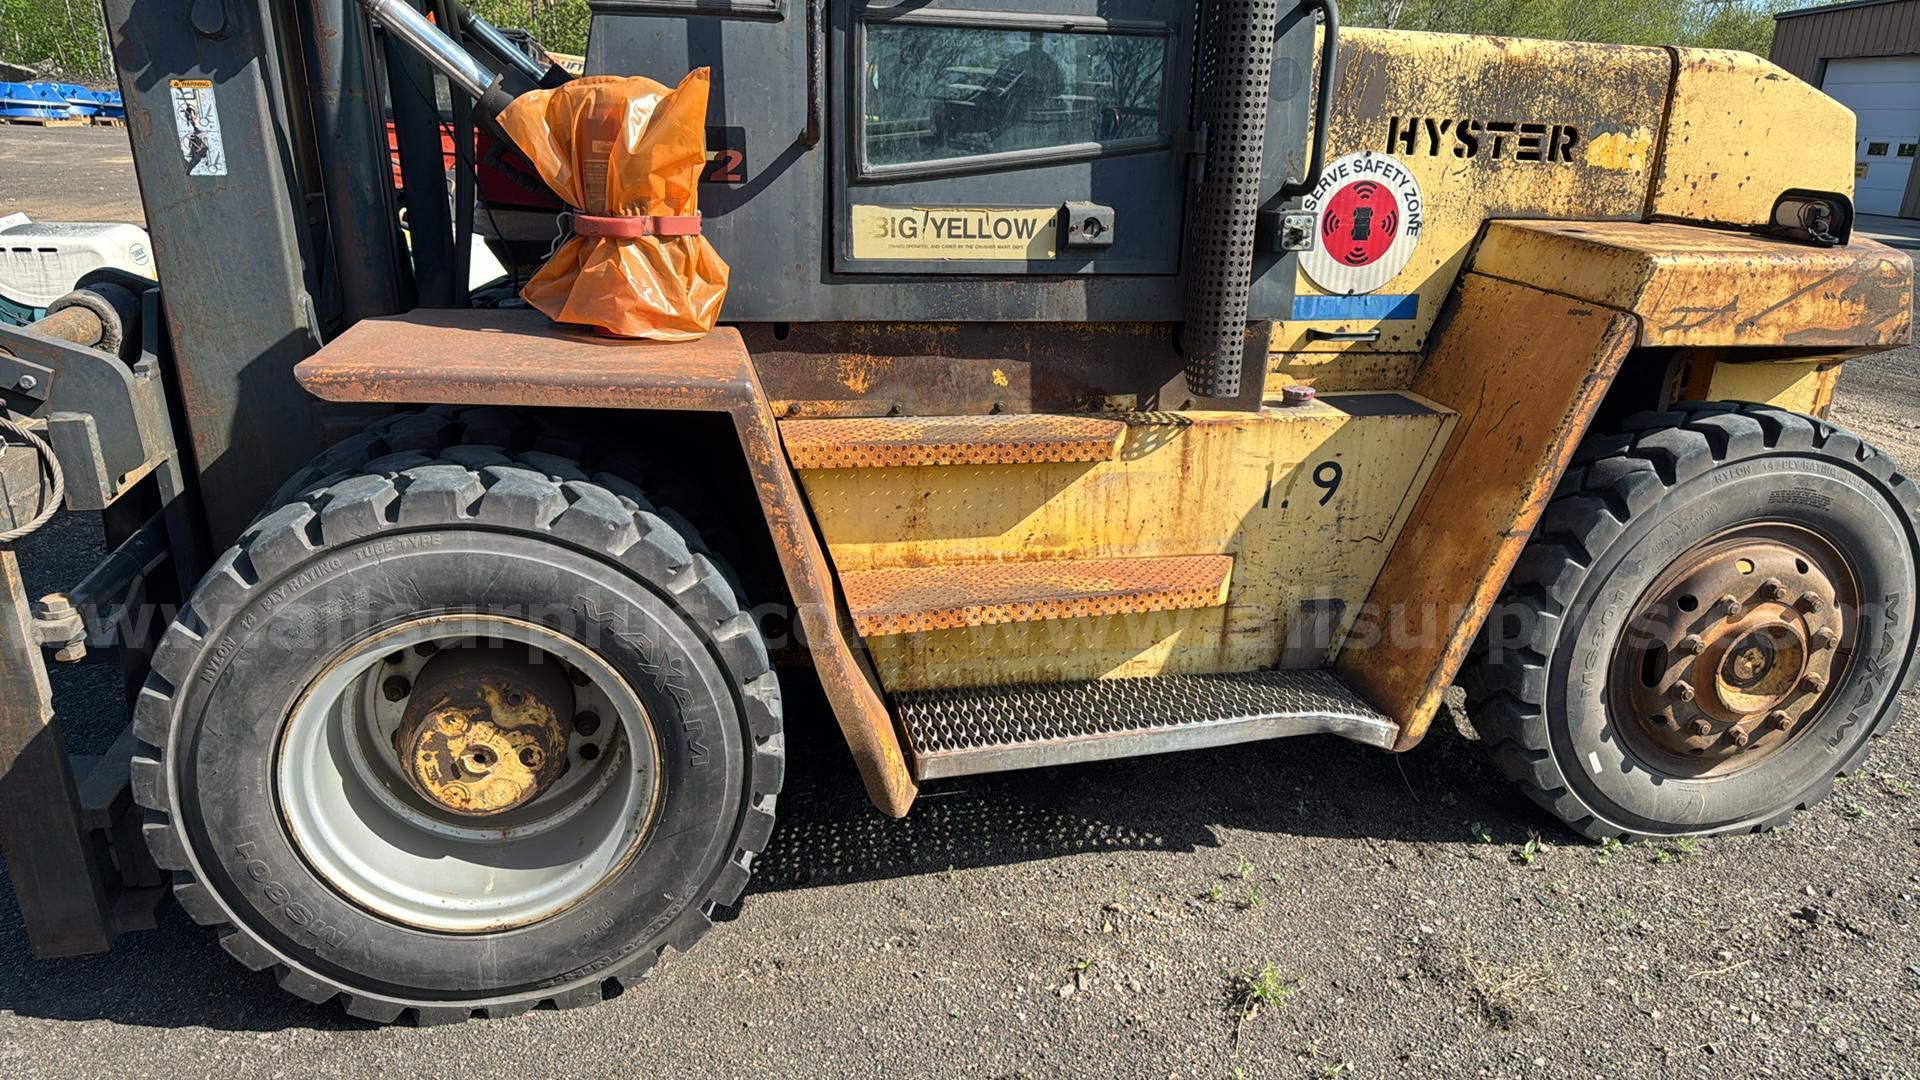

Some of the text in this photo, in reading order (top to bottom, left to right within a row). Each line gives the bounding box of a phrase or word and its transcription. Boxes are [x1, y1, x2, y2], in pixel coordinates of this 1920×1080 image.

[1386, 116, 1579, 163] HYSTER
[930, 217, 1038, 240] YELLOW
[1303, 158, 1420, 238] SERVE SAFETY ZONE
[1714, 466, 1752, 484] NYLON
[200, 635, 238, 685] NYLON
[240, 612, 258, 632] 14
[261, 582, 289, 613] PLY
[288, 557, 343, 593] RATING
[352, 540, 397, 562] TUBE
[397, 533, 443, 551] TYPE
[568, 592, 711, 768] MAXAM
[1824, 591, 1900, 752] MAXAM
[234, 840, 348, 949] MS801
